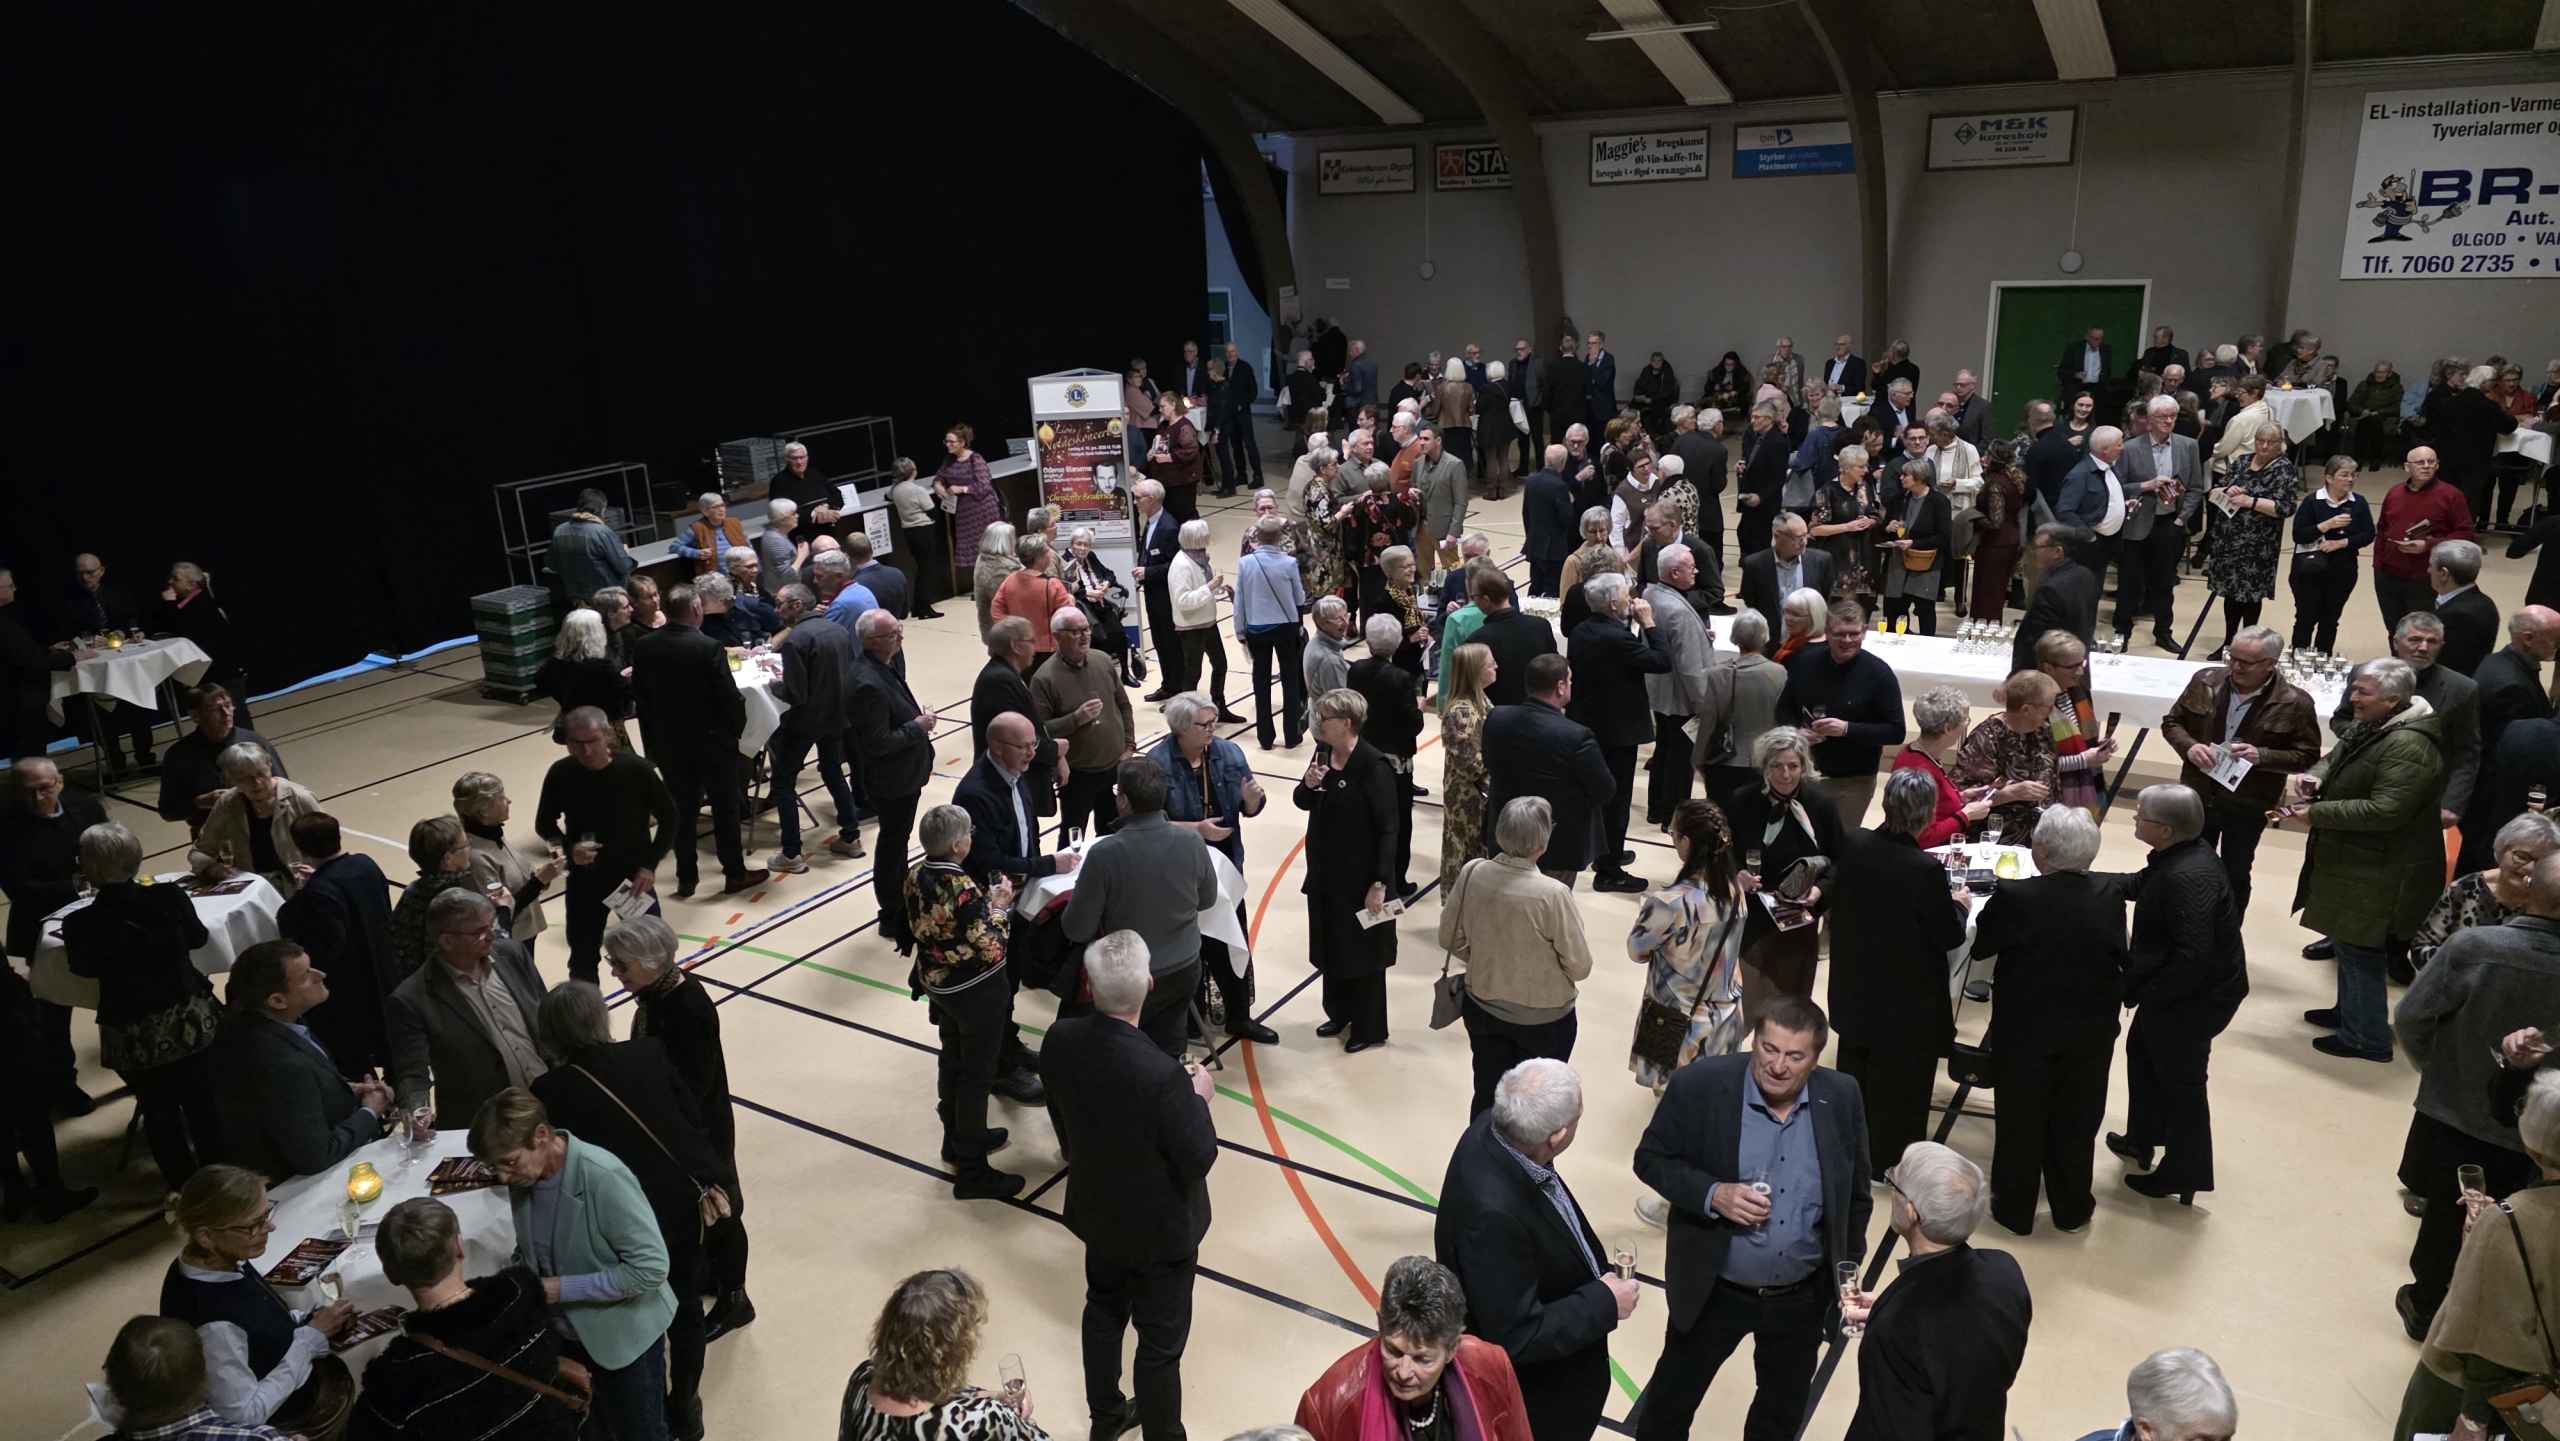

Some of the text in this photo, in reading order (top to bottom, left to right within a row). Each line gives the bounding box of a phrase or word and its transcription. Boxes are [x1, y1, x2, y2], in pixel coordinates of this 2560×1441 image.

[1980, 117, 2048, 131] M&K
[2432, 121, 2560, 142] Tyverialarmer o
[1595, 136, 1647, 163] Maggie's
[2505, 209, 2555, 226] Aut.
[2451, 232, 2507, 247] ØLGOD
[2362, 254, 2514, 273] Tlf. 7060 2735
